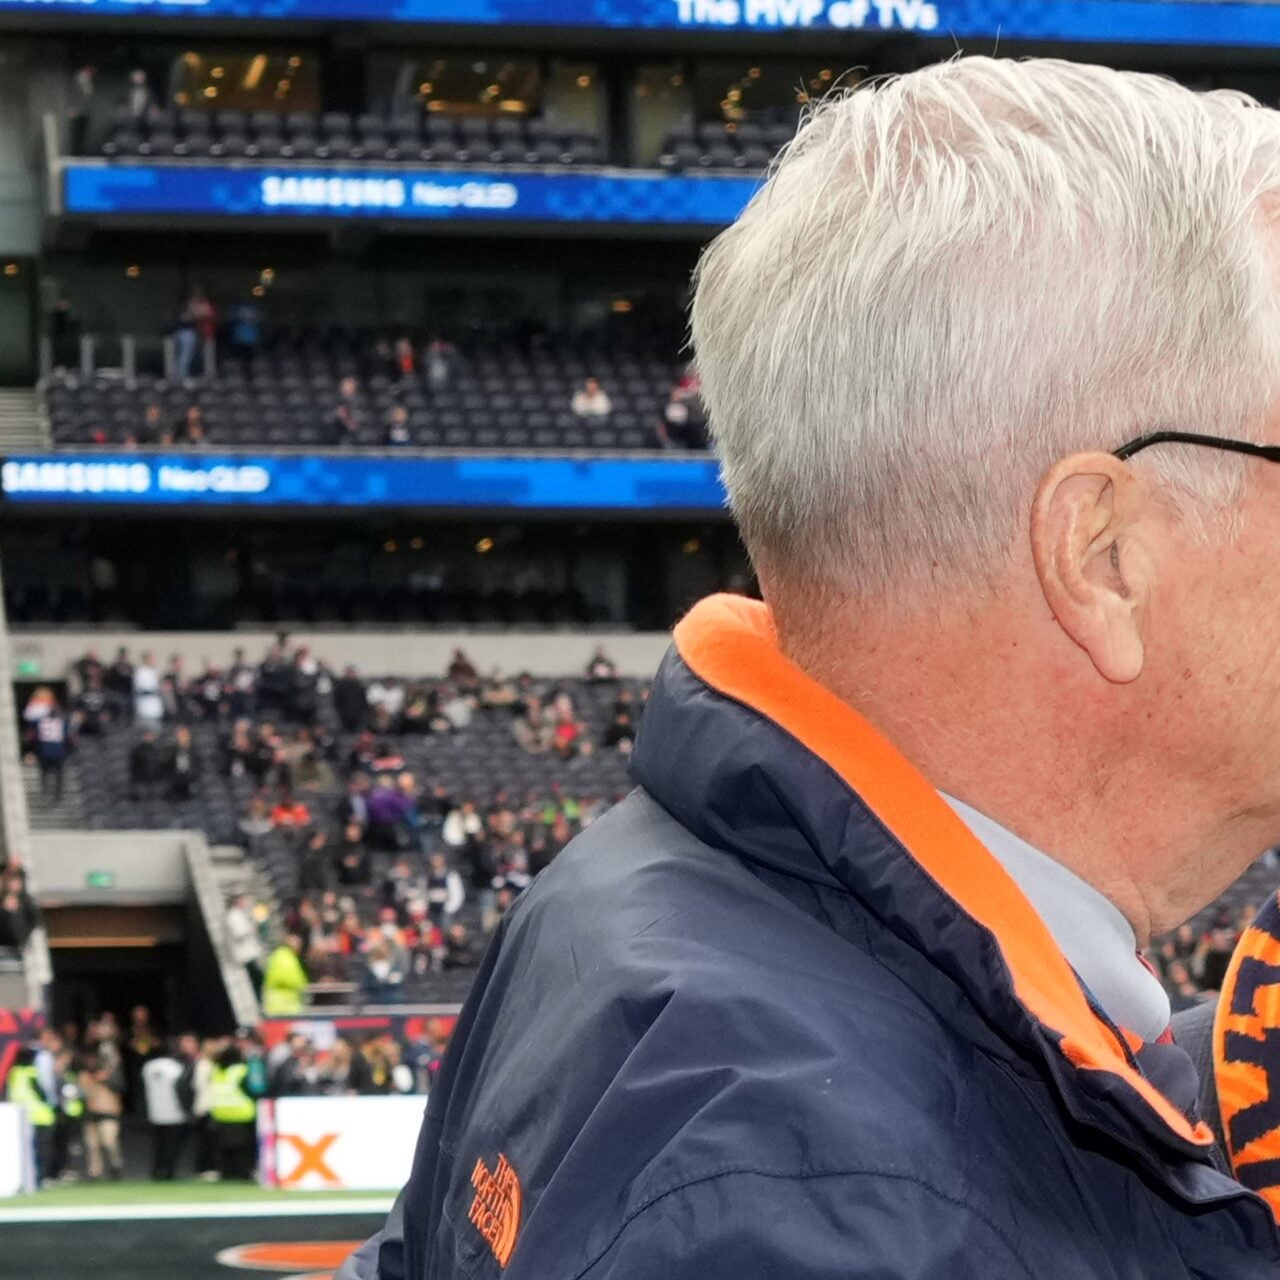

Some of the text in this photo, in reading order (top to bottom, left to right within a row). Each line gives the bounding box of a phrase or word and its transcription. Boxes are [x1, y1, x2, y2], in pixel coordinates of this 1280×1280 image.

[674, 0, 938, 31] The MVP of TVs
[261, 176, 405, 207] SAMSUNG
[1, 461, 151, 493] SAMSUNG
[470, 1157, 510, 1222] NORTH
[493, 1152, 518, 1198] THE
[467, 1193, 503, 1243] FACE
